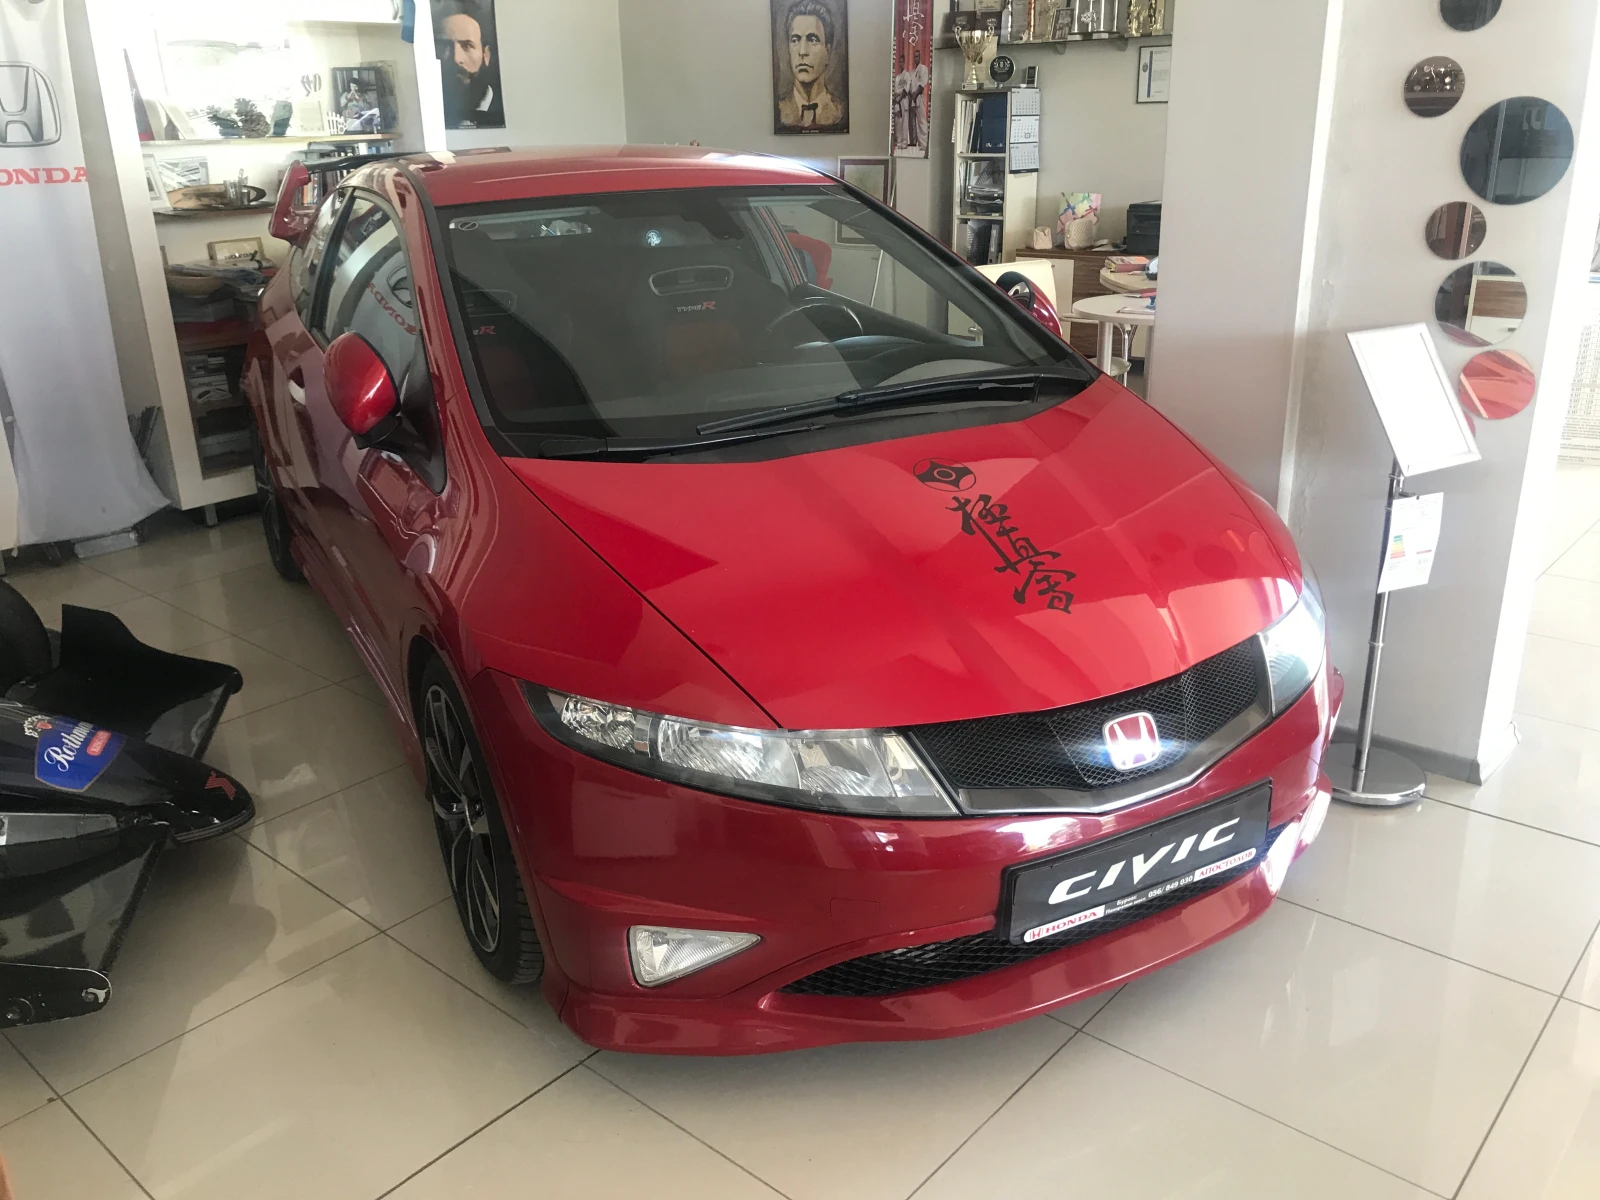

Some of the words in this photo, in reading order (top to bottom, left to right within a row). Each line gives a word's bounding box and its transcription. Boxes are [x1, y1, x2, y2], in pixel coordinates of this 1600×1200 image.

[0, 166, 88, 186] ONDA
[1048, 816, 1241, 905] CIVIC
[1198, 850, 1253, 877] АПОСТОЛОВ
[1165, 881, 1179, 892] 849
[1179, 875, 1194, 886] 030
[1045, 911, 1097, 933] HONDA
